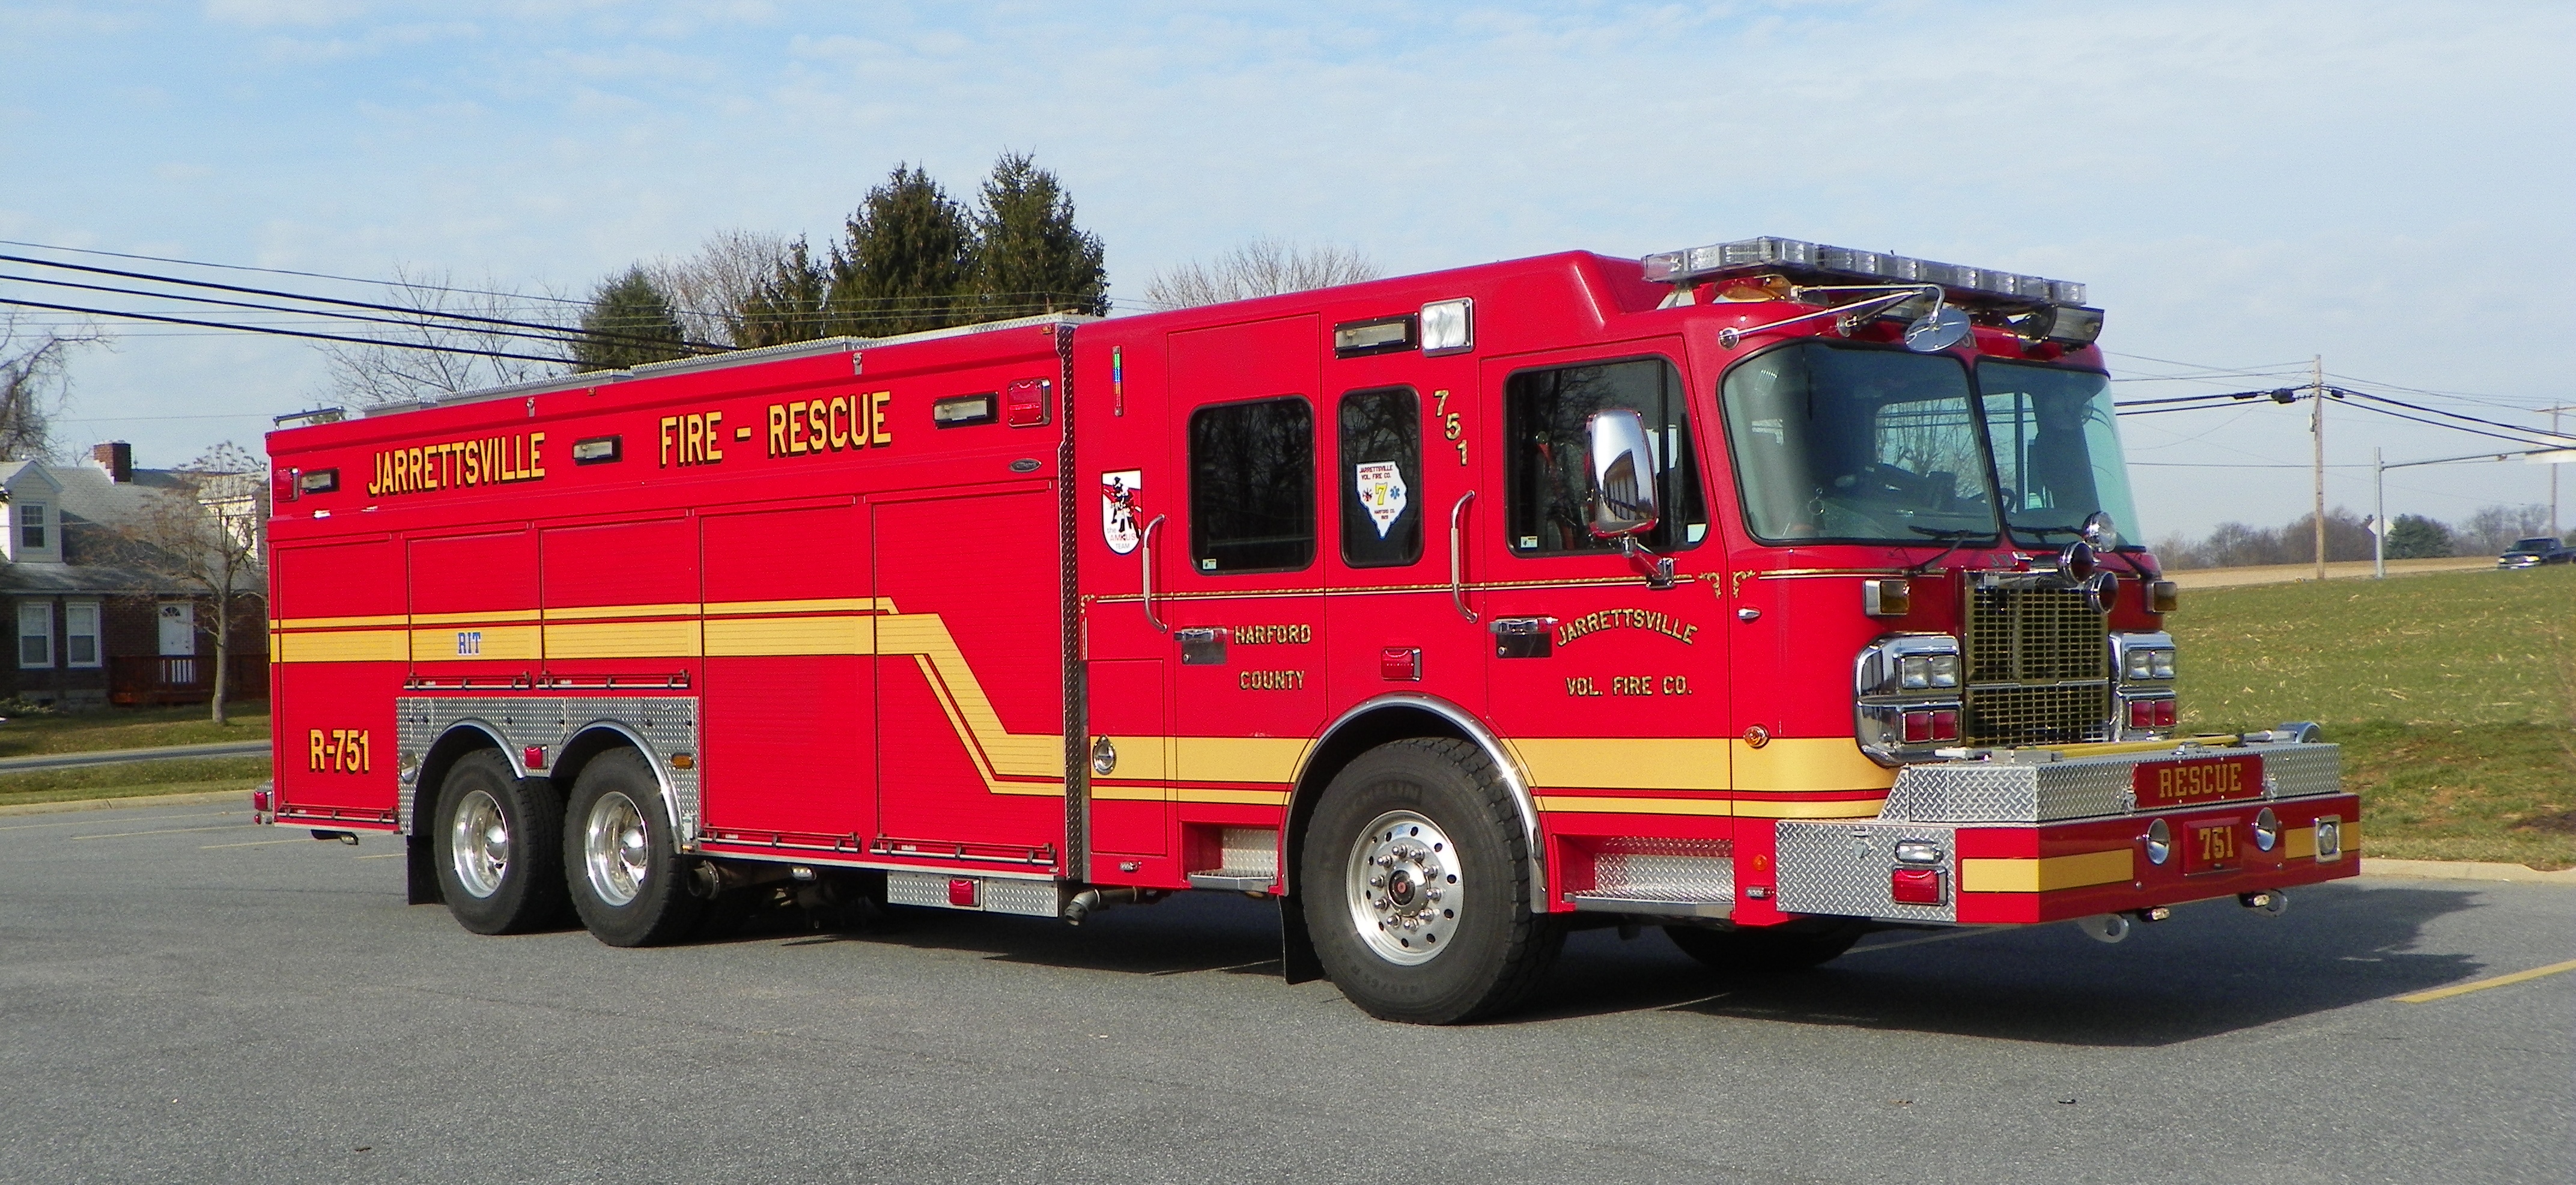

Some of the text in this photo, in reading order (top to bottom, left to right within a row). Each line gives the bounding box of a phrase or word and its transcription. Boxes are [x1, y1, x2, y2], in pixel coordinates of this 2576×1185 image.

[660, 411, 723, 467] FIRE
[768, 391, 892, 458] RESCUE
[368, 431, 545, 496] JARRETTSVILLE
[1376, 483, 1388, 505] 7
[457, 632, 481, 654] RIT
[1235, 624, 1311, 644] HARFORD
[1557, 608, 1698, 647] JARRETTSVILLE
[1239, 670, 1305, 690] COUNTY
[1566, 675, 1693, 696] VOL. FIRE CO.
[309, 728, 371, 774] R-751
[2158, 763, 2242, 799] RESCUE
[2199, 826, 2234, 861] 751
